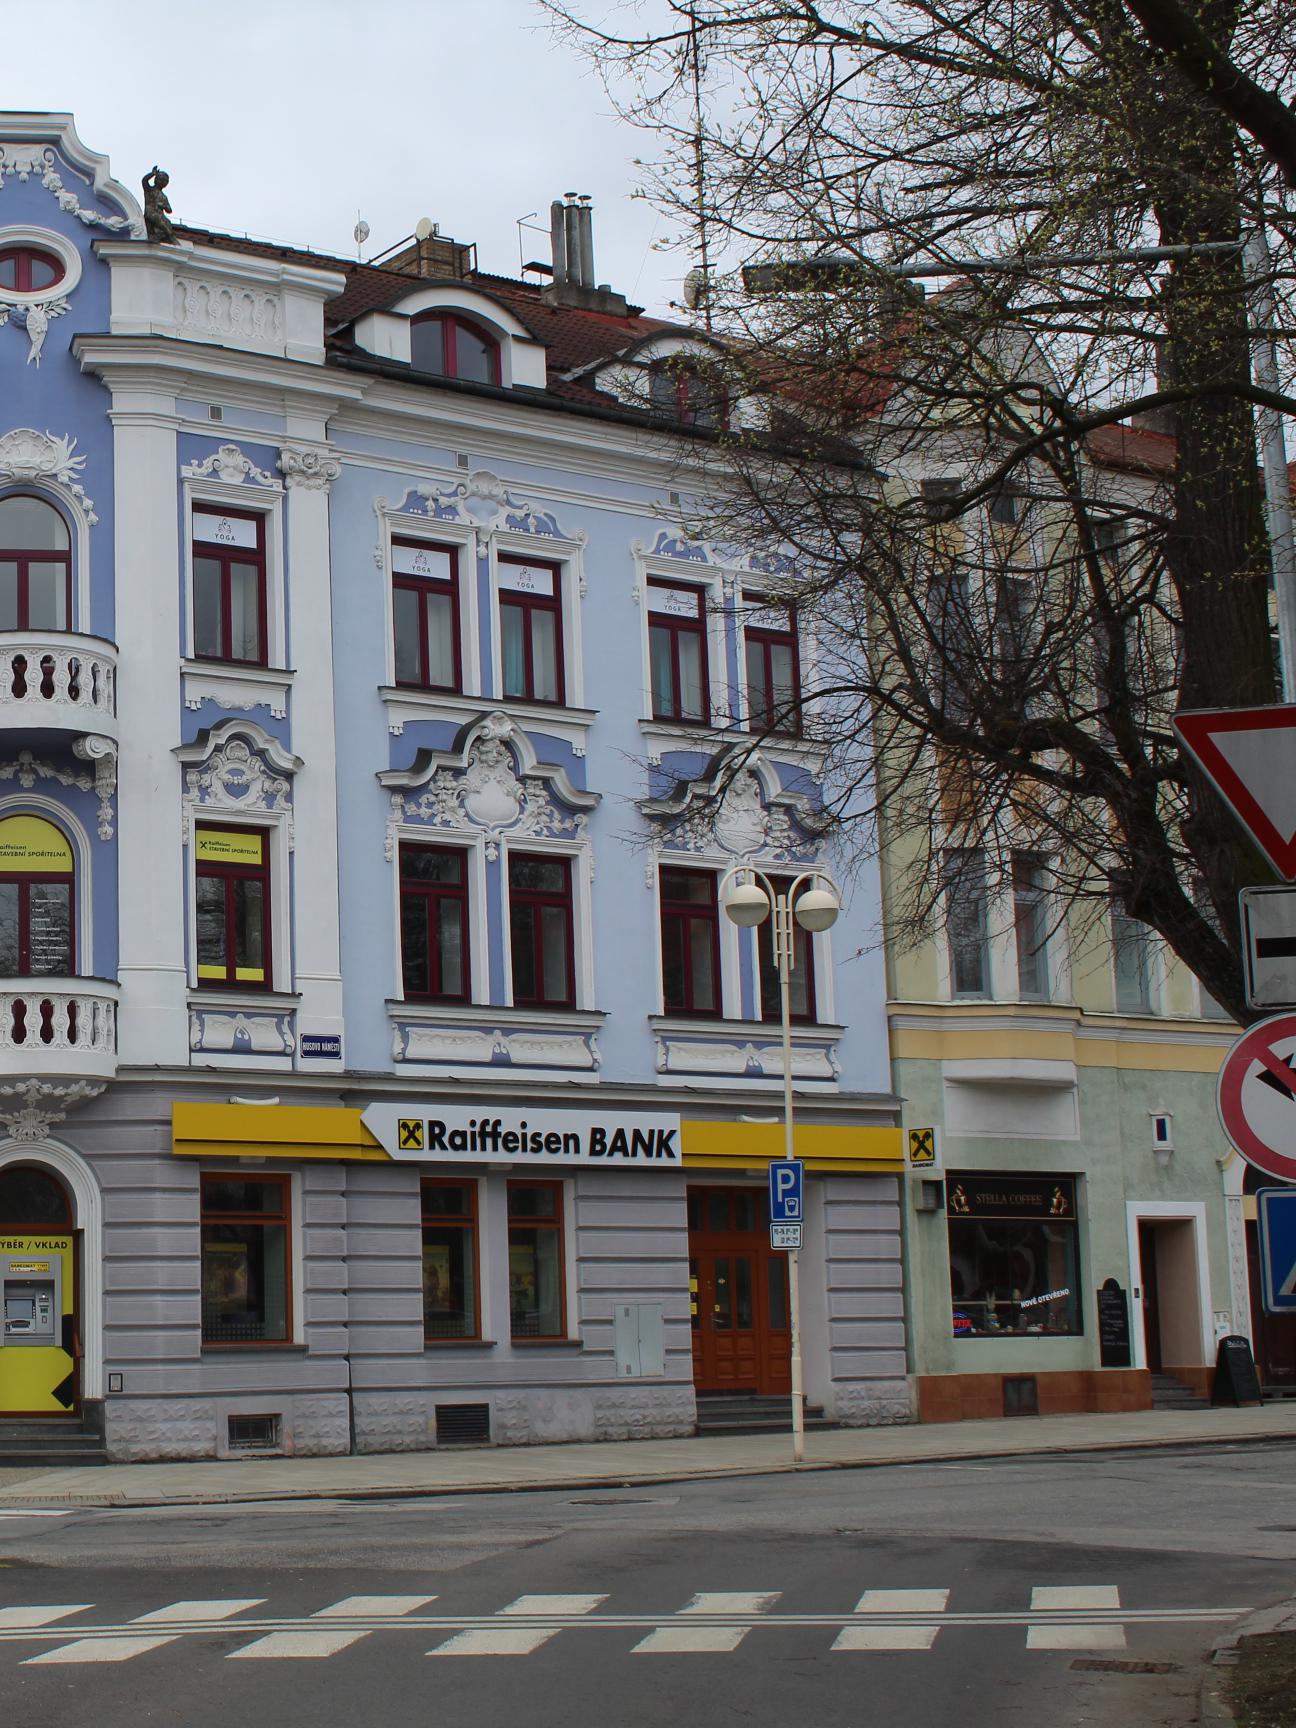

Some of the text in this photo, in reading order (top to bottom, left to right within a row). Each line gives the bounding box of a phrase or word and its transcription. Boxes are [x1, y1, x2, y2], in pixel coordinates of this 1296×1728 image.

[215, 533, 236, 542] YOGA
[412, 565, 431, 573] YOGA
[303, 1041, 320, 1051] HUSOVO
[427, 1118, 678, 1158] Raiffeisen BANK
[776, 1168, 795, 1203] P
[976, 1193, 1042, 1205] STELLA COFFEE
[34, 1241, 68, 1249] VKLAD
[1037, 1288, 1070, 1304] OTEVŘENO
